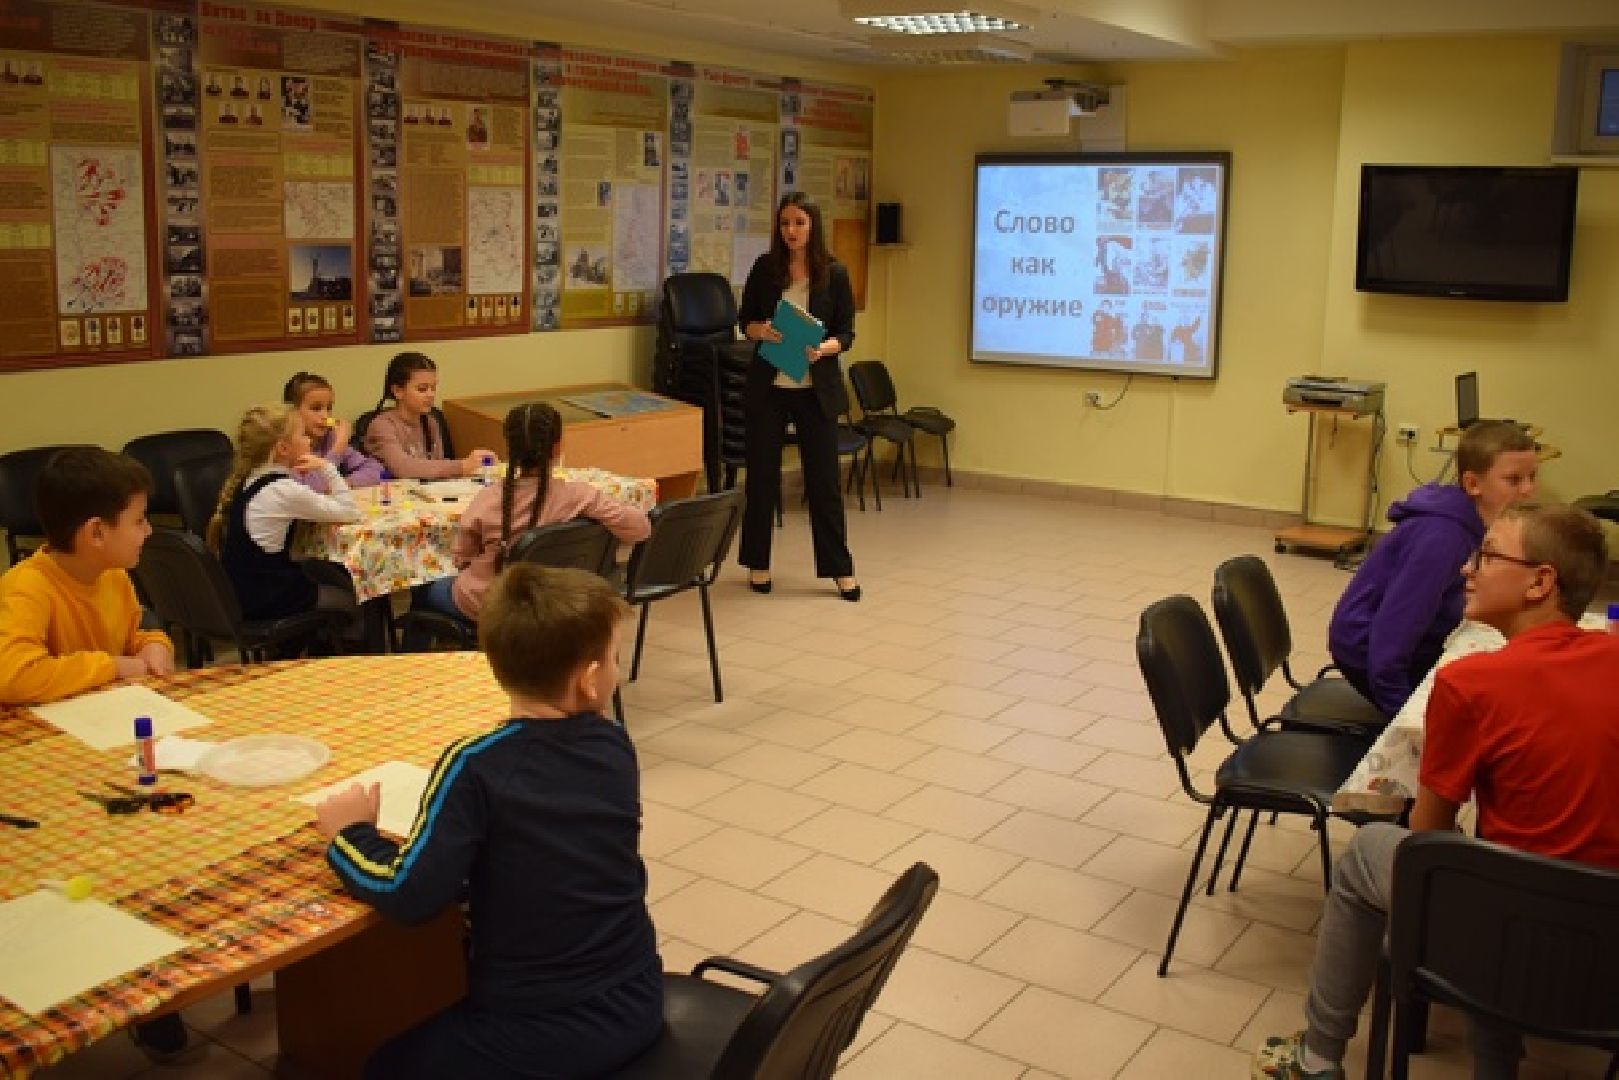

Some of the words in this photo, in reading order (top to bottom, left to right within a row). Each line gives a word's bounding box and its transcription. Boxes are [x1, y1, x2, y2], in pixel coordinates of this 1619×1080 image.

[994, 209, 1076, 234] Слово
[1010, 256, 1057, 276] как
[982, 296, 1084, 319] оружие
